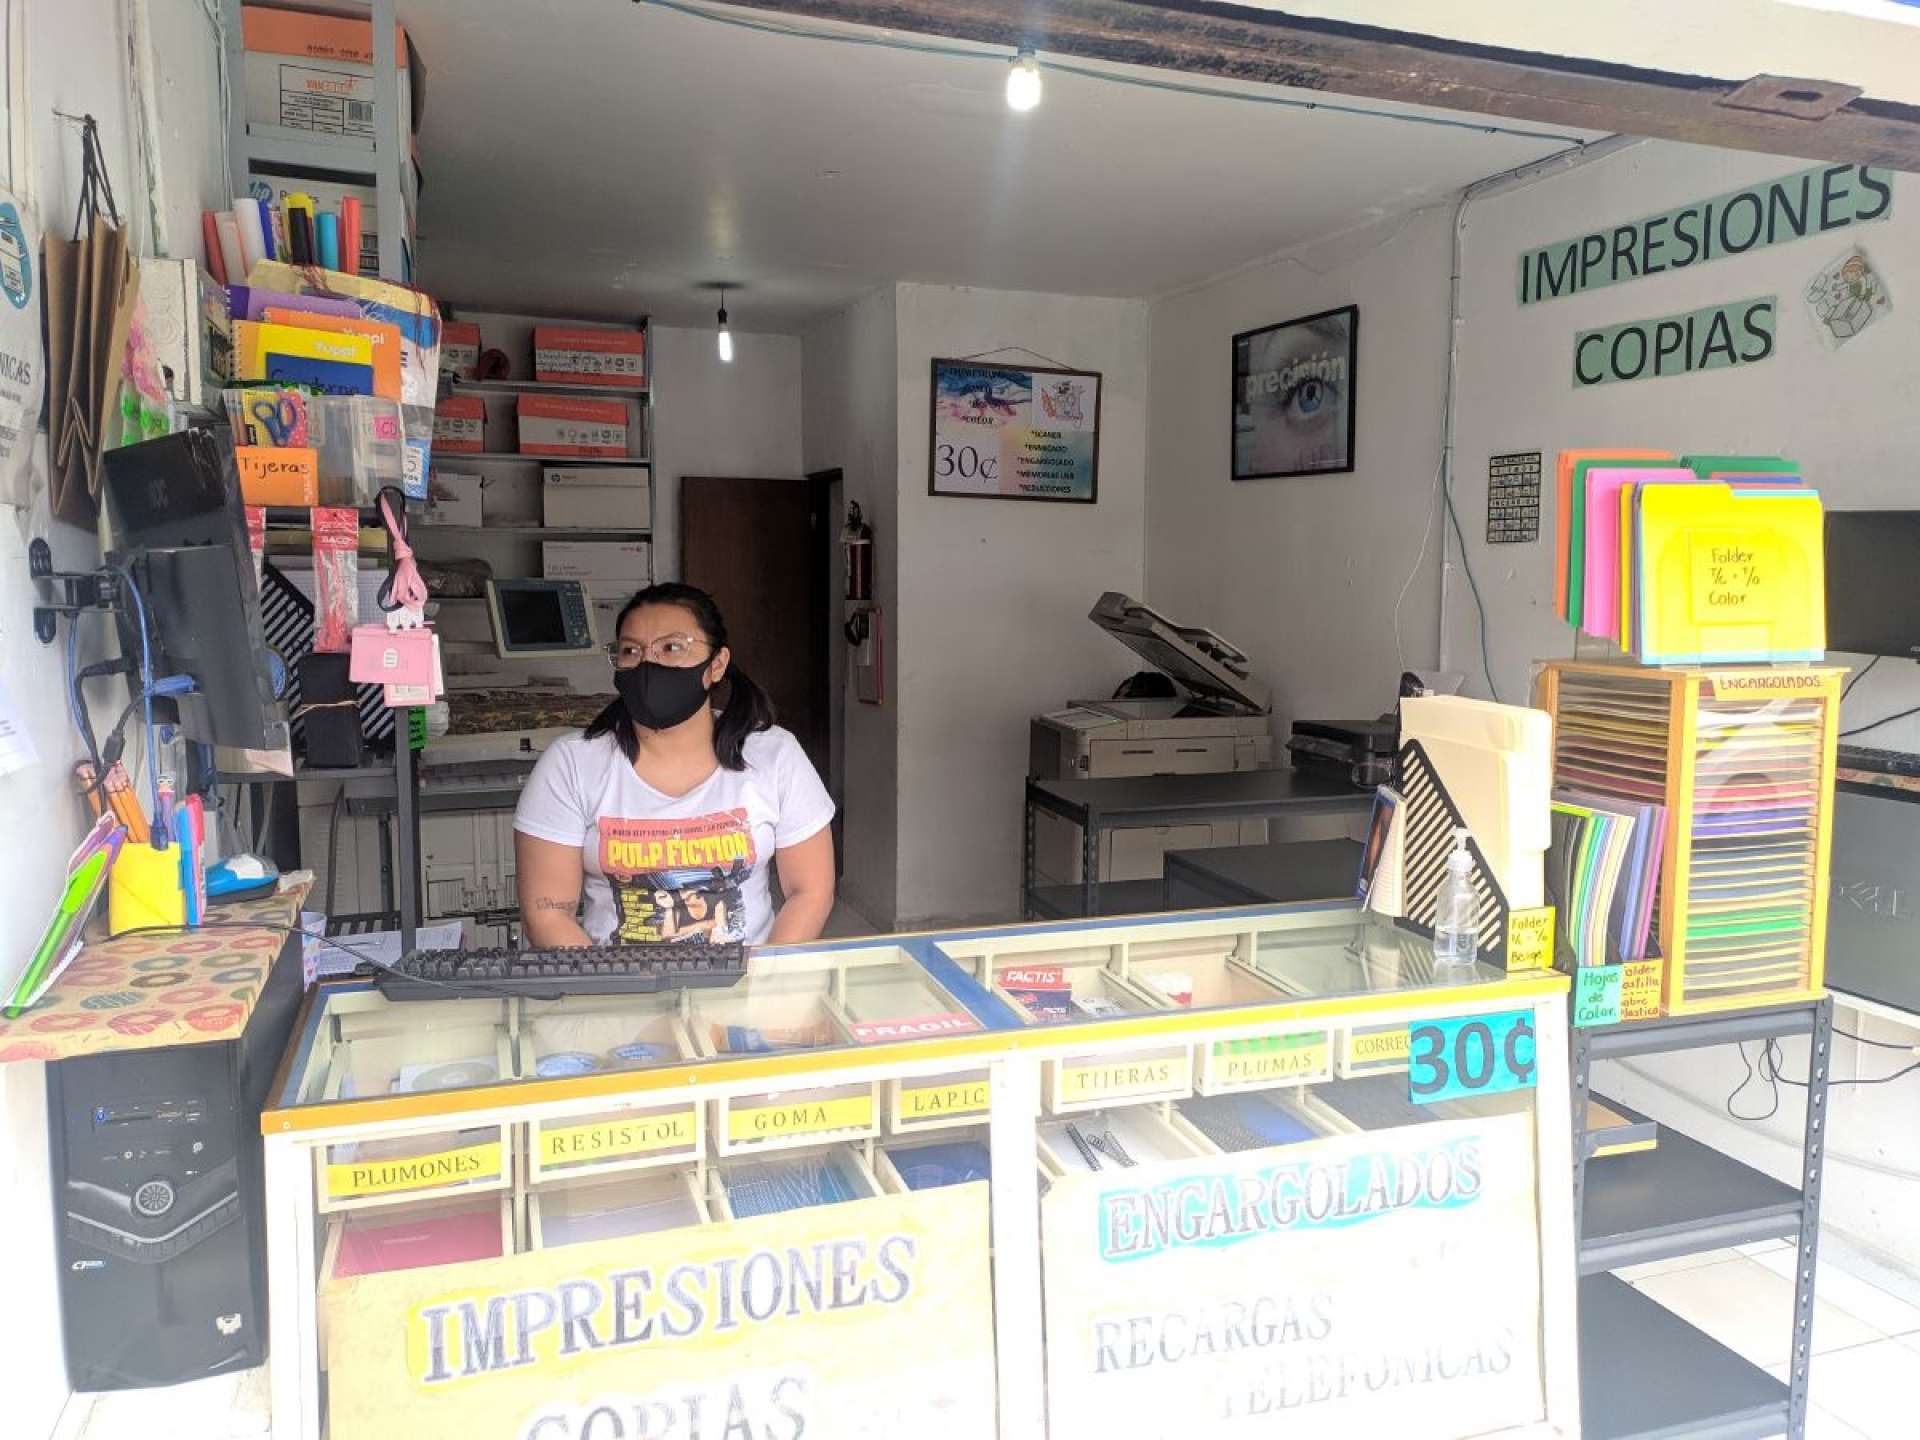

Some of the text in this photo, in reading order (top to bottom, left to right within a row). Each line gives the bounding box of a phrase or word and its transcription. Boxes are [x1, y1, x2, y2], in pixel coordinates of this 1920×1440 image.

[1522, 163, 1893, 306] IMPRESIONES
[1575, 302, 1774, 386] COPIAS
[239, 457, 310, 479] Tijeras
[935, 444, 998, 483] 30¢
[1710, 547, 1754, 564] Folder
[1708, 591, 1747, 606] Color
[1719, 675, 1822, 690] ENGARGOLADOS
[607, 831, 748, 869] PULP FICTION
[1511, 915, 1550, 930] Folder
[1005, 970, 1058, 984] FACTIS
[1583, 970, 1619, 992] Hojas
[1623, 964, 1657, 977] older
[1621, 976, 1660, 990] astilla
[1588, 992, 1604, 1004] de
[1621, 996, 1649, 1007] obre
[853, 1017, 973, 1039] FRAGIL
[1354, 1035, 1410, 1056] CORRE
[1411, 1017, 1536, 1096] 30¢
[1227, 1053, 1314, 1077] PLUMAS
[1075, 1065, 1171, 1090] TIJERAS
[913, 1087, 985, 1112] LAPIC
[753, 1105, 828, 1131] GOMA
[551, 1119, 686, 1155] RESISTOL
[352, 1155, 481, 1189] PLUMONES
[1104, 1142, 1483, 1257] ENGARGOLADOS
[422, 1235, 918, 1384] IMPRESIONES
[1093, 1293, 1333, 1374] RECARGAS
